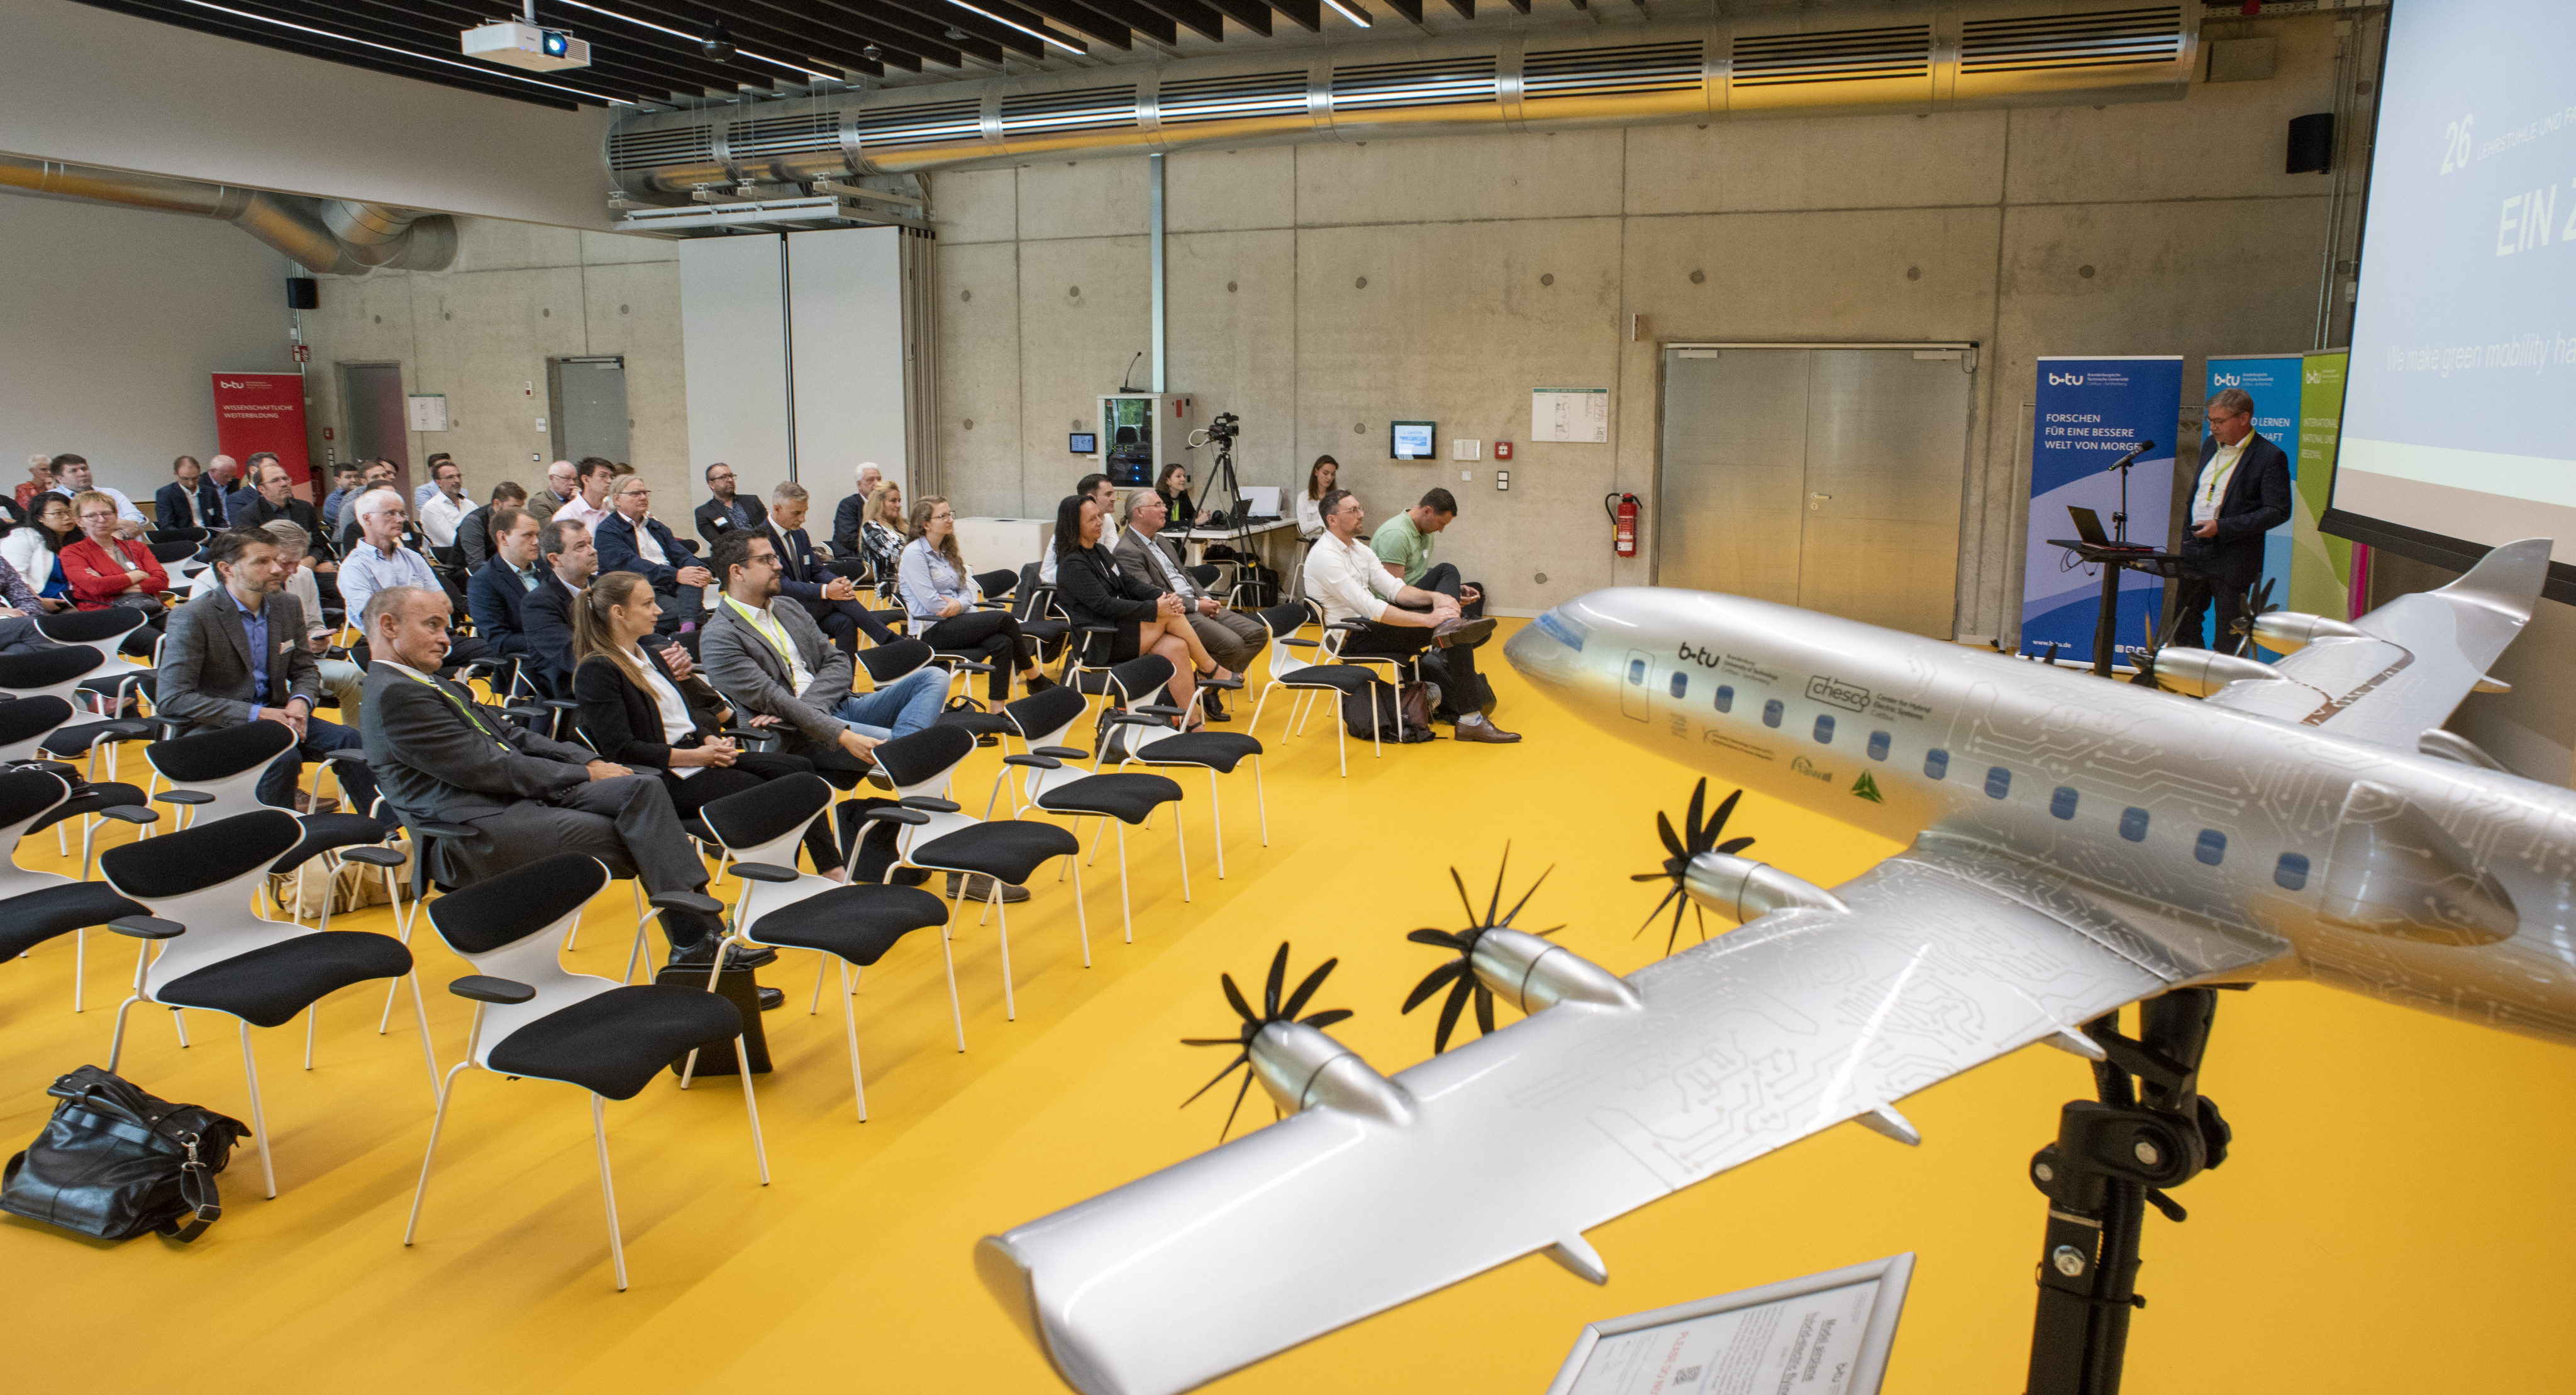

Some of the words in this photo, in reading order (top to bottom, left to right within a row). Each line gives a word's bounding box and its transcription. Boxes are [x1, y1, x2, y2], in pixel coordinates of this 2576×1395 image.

[2440, 113, 2473, 175] 26
[2539, 111, 2562, 135] UND
[2496, 184, 2557, 257] EIN
[2387, 345, 2404, 372] We
[2407, 343, 2439, 371] make
[2442, 345, 2482, 377] green
[2485, 332, 2550, 375] mobility
[2045, 426, 2065, 436] FÜR
[2067, 428, 2090, 436] EINE
[2092, 428, 2135, 437] BESSERE
[2046, 414, 2101, 423] FORSCHEN
[2259, 418, 2290, 426] LERNEN
[2045, 441, 2072, 449] WELT
[2075, 442, 2098, 450] VON
[2101, 442, 2143, 451] MORGE
[1813, 677, 1871, 707] chesco
[1665, 1331, 1689, 1365] PLEASE
[1657, 1365, 1672, 1378] DO
[1802, 1345, 1824, 1382] airplane
